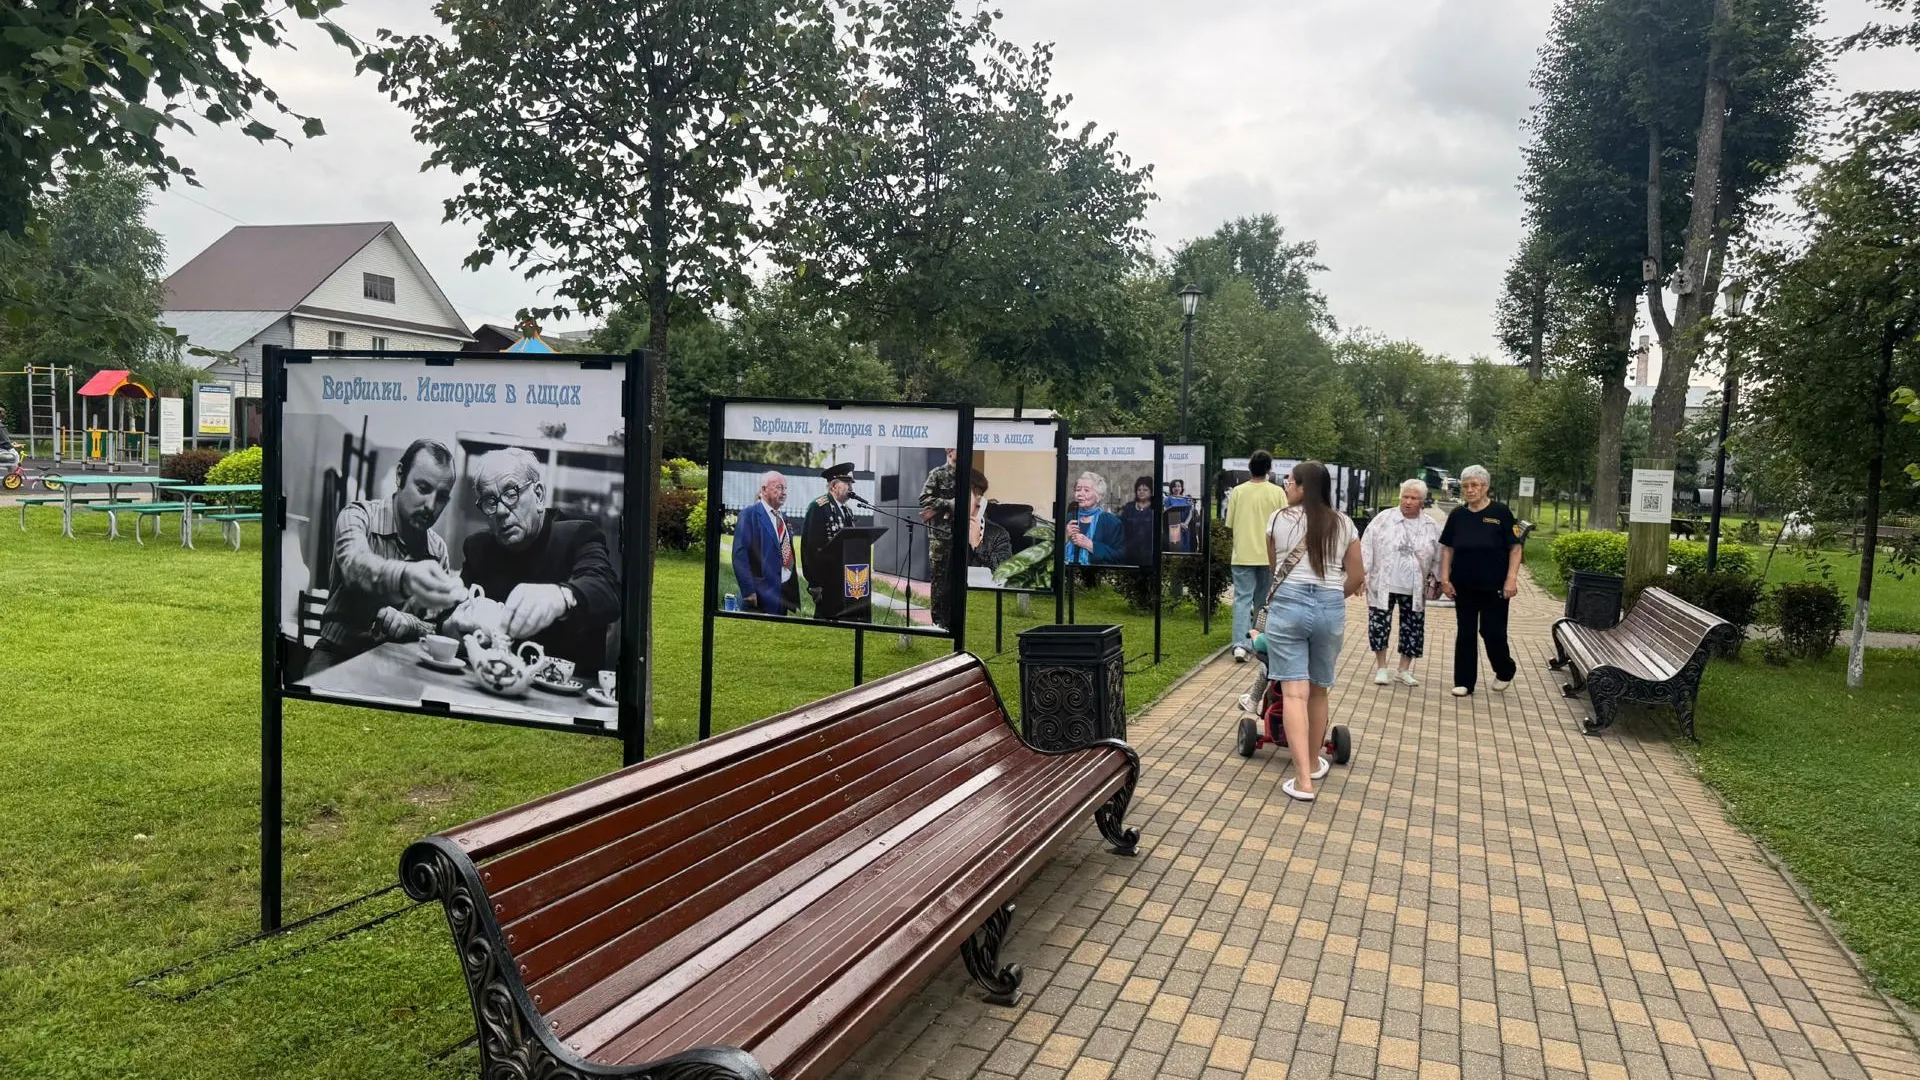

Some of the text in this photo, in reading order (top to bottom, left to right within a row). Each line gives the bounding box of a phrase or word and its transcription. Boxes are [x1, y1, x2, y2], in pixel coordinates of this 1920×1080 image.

[322, 375, 581, 408] Вербилки. История в лицах
[752, 416, 929, 440] Вербилки. История в лицах
[1004, 433, 1034, 445] лицах
